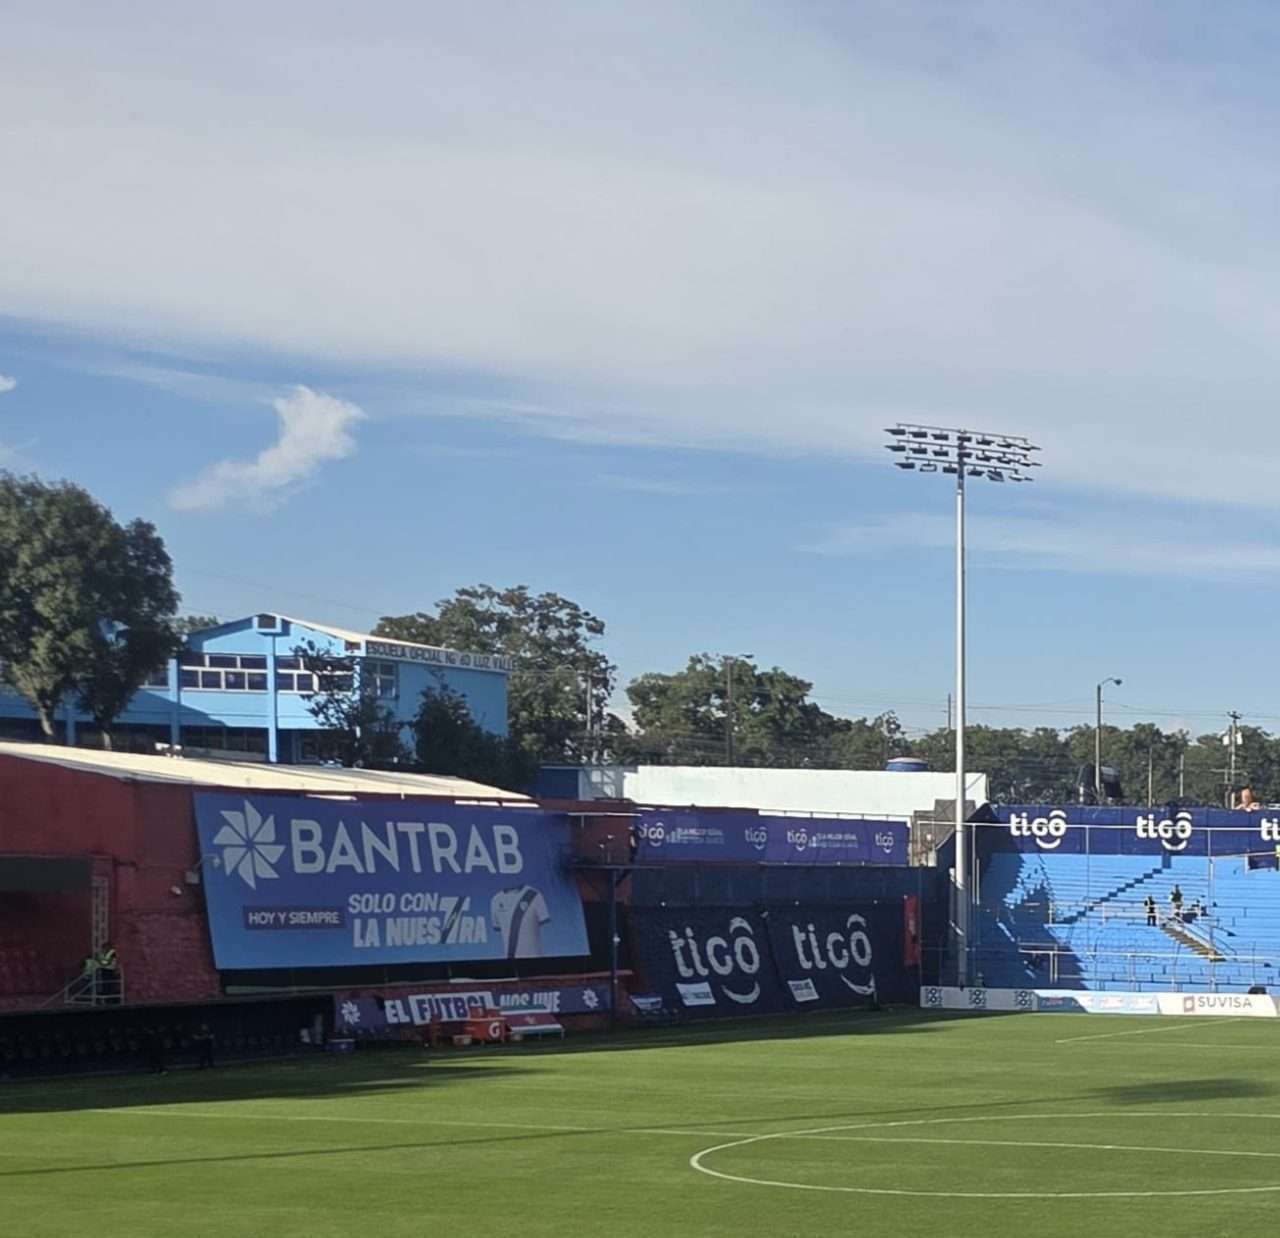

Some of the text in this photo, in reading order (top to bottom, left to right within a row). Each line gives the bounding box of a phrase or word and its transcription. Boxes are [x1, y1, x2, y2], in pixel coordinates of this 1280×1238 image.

[367, 642, 407, 658] ESCUELA
[290, 819, 524, 875] BANTRAB
[348, 892, 438, 914] SOLO CON
[248, 910, 341, 925] HOY Y SIEMPRE
[353, 920, 380, 948] LA
[1198, 996, 1253, 1009] SUVISA
